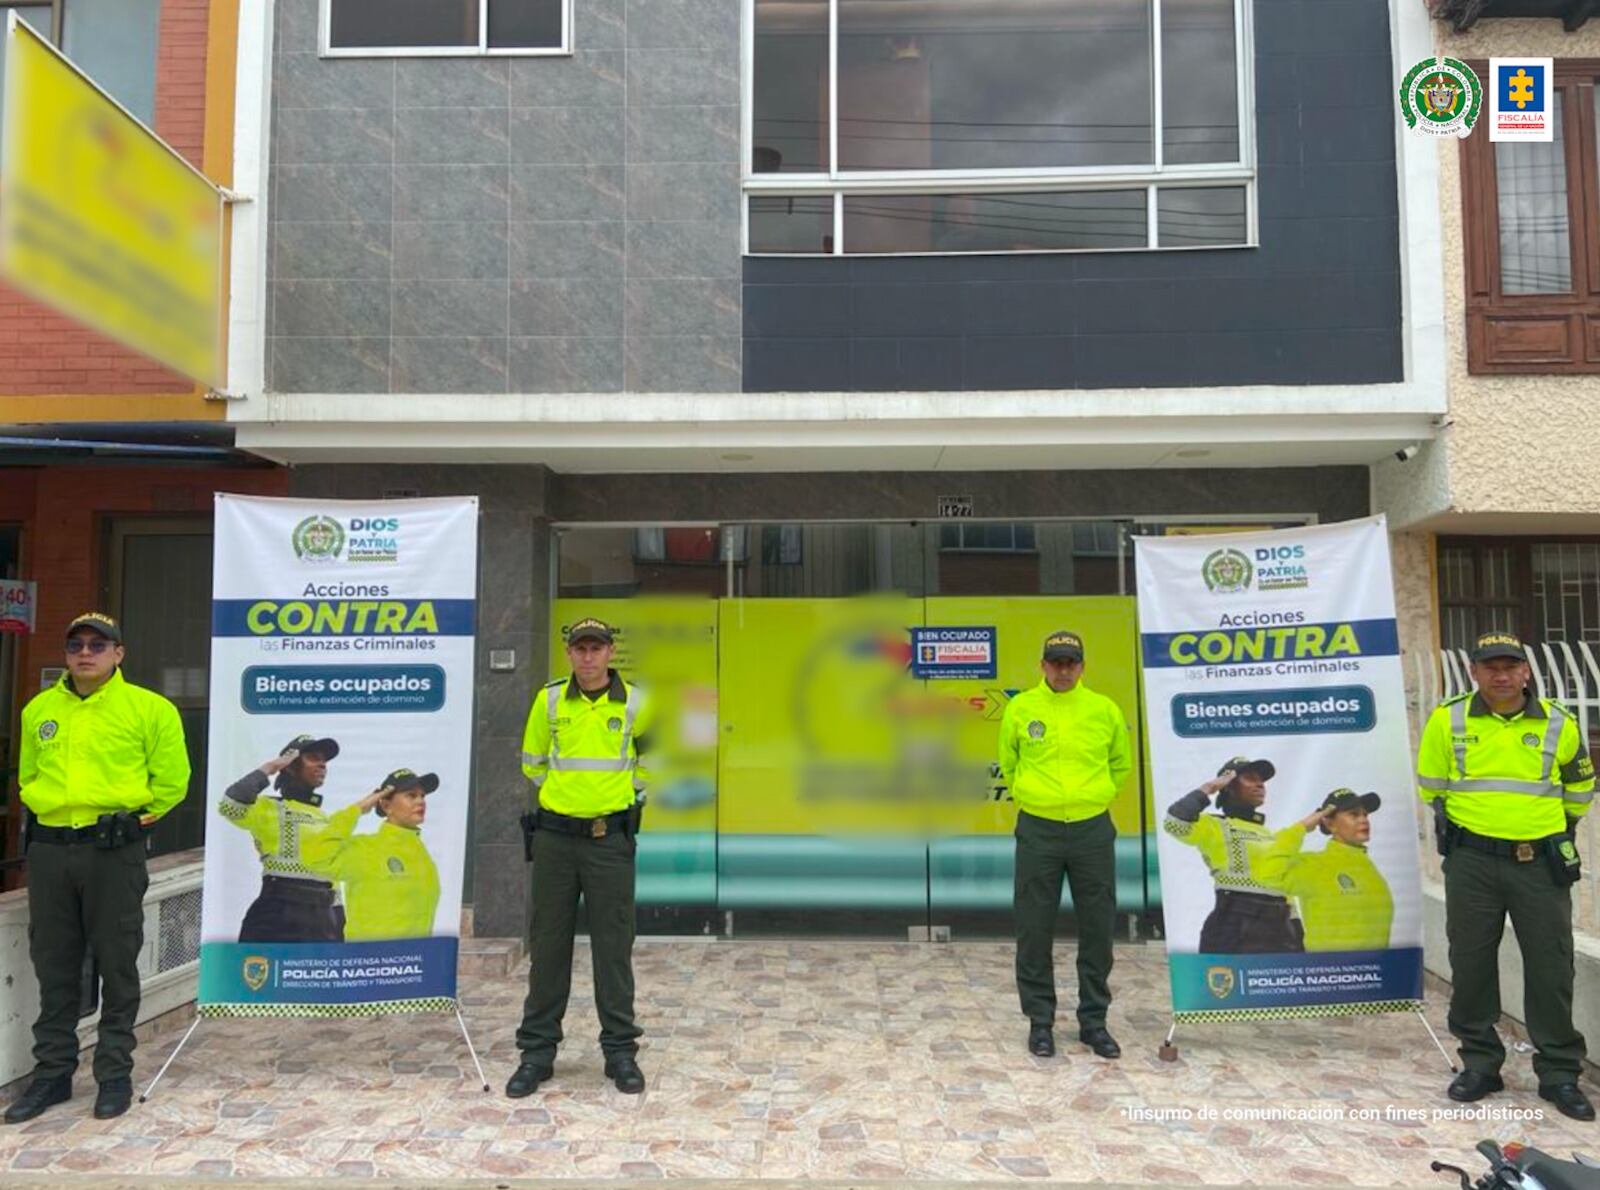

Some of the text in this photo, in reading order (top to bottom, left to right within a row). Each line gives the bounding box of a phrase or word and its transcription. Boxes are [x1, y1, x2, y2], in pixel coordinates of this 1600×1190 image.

[350, 518, 398, 532] DIOS
[349, 538, 396, 548] PATRIA
[1255, 545, 1304, 561] DIOS
[1258, 566, 1306, 577] PATRIA
[303, 582, 390, 598] Acciones
[247, 601, 439, 634] CONTRA
[1219, 610, 1304, 628] Acciones
[918, 631, 990, 640] BIEN OCUPADO
[1478, 635, 1521, 648] POLICIA
[260, 636, 436, 650] las Finanzas Criminales
[1169, 624, 1362, 664] CONTRA
[1206, 664, 1272, 678] Finanzas
[1275, 660, 1360, 676] Criminales
[256, 675, 431, 694] Bienes ocupados
[258, 694, 425, 705] con fines de extinción de dominio
[1184, 696, 1360, 718] Bienes ocupados
[1190, 716, 1356, 730] con fines de extinción de dominio
[342, 958, 380, 966] DEFENSA
[382, 955, 422, 964] NACIONAL
[282, 965, 423, 979] POLICÍA NACIONAL
[1304, 966, 1341, 974] DEFENSA
[321, 980, 330, 988] DE
[375, 976, 422, 986] TRANSPORTE
[1248, 973, 1382, 987] POLICÍA NACIONAL
